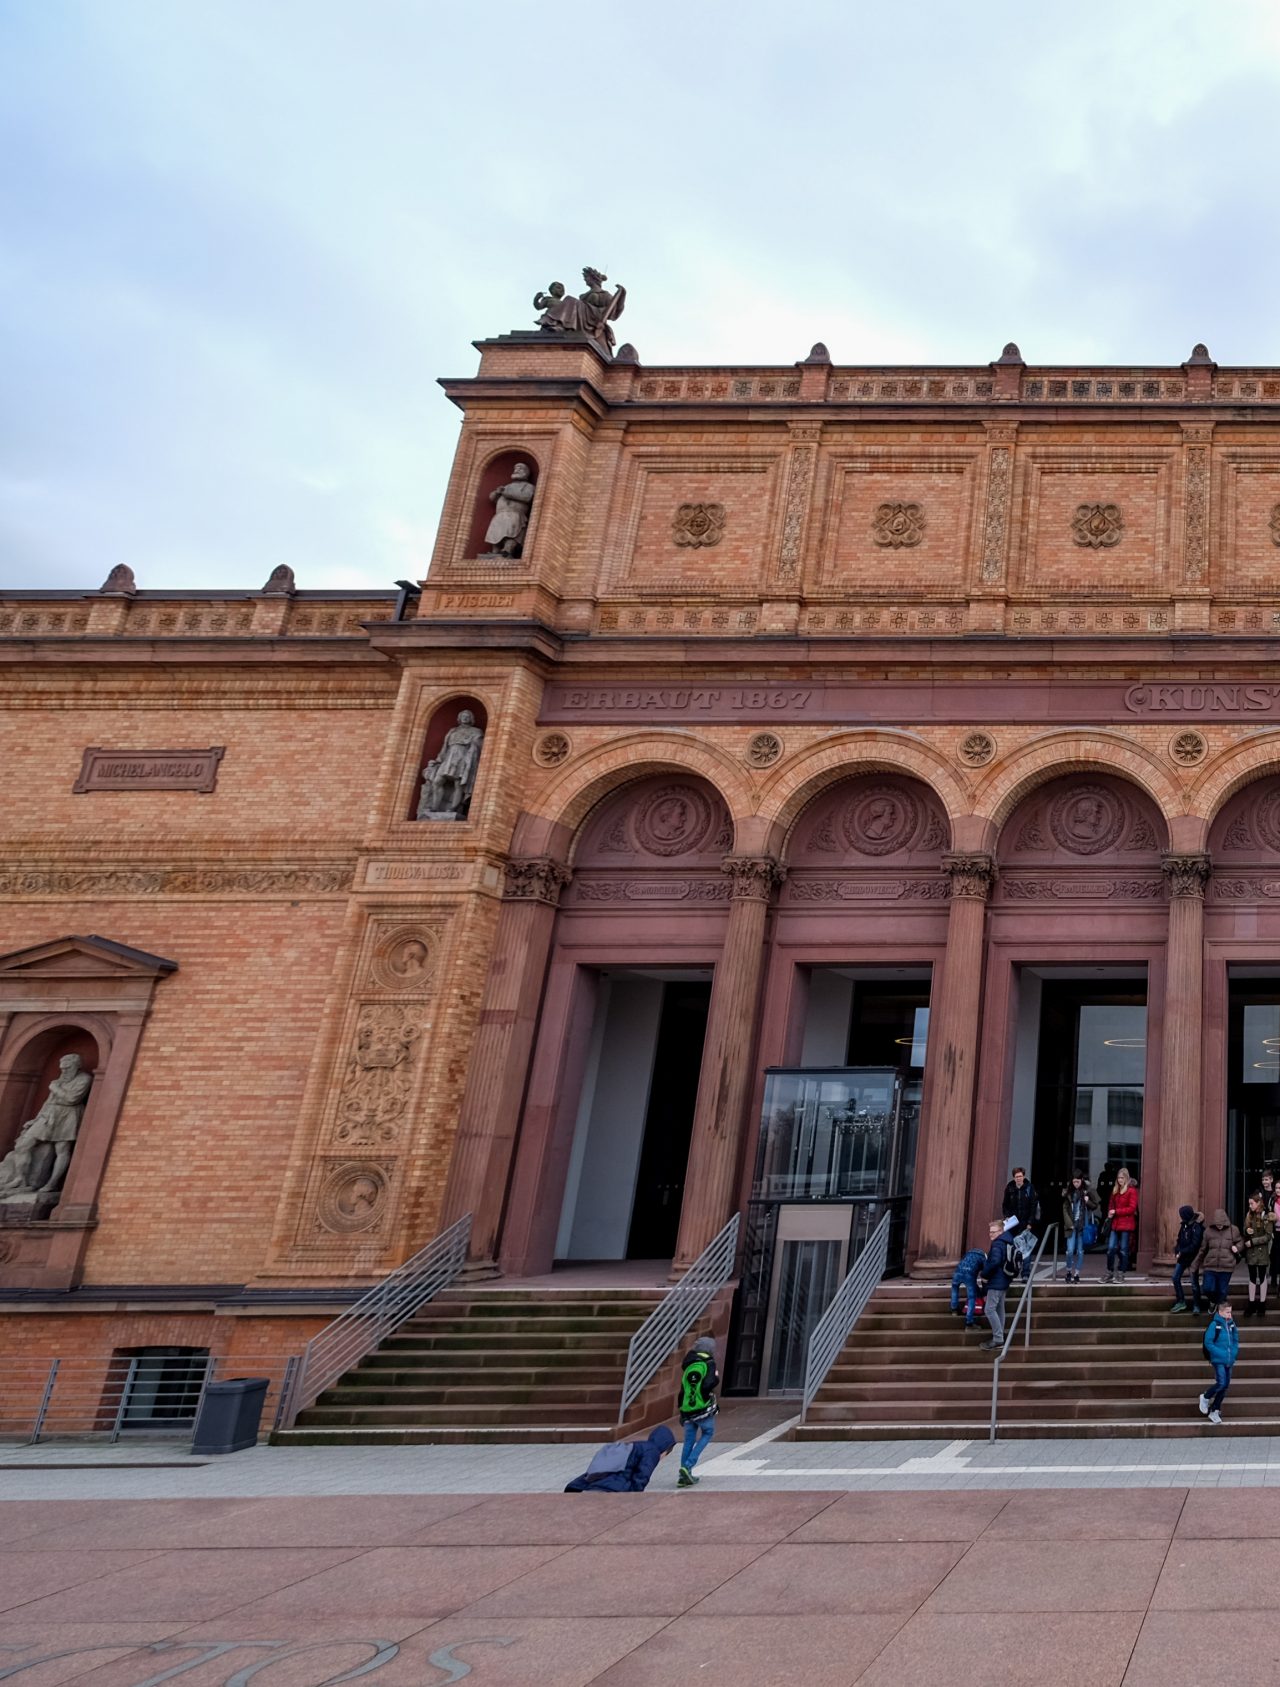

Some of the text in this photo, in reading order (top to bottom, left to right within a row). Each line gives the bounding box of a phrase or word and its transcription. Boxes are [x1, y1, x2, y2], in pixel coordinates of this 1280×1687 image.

[444, 595, 513, 608] P.VISCHER
[561, 689, 812, 710] ERBAUT 1867
[98, 763, 204, 778] MICHELANGELO
